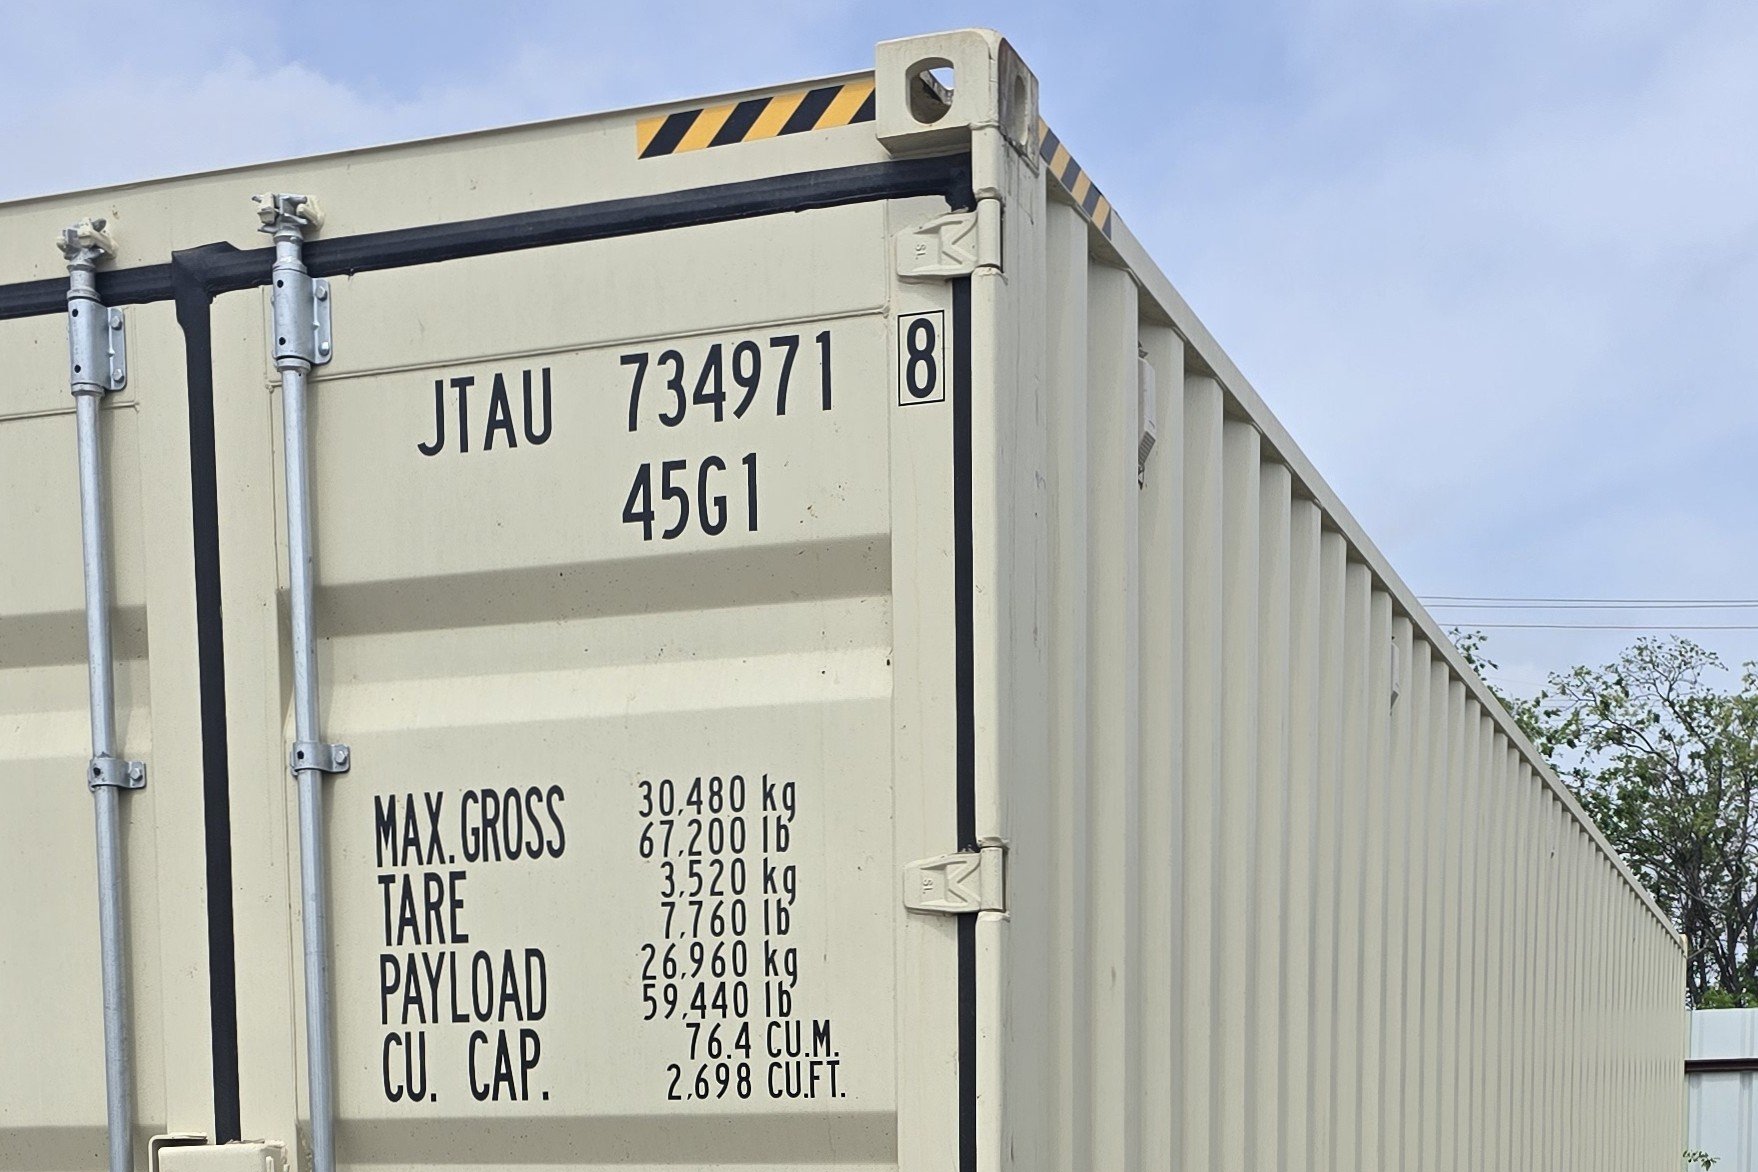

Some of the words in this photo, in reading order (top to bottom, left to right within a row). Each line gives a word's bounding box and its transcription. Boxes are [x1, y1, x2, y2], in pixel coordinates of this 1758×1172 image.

[417, 367, 552, 457] JTAU
[619, 330, 832, 433] 734971
[906, 317, 937, 399] 8
[622, 452, 758, 542] 45G1
[638, 774, 746, 818] 30,480
[762, 773, 796, 824] kg
[639, 816, 746, 859] 67,200
[762, 814, 790, 854] lb
[660, 857, 746, 899] 3,520
[762, 856, 796, 907] kg
[377, 870, 469, 947] TARE
[660, 898, 747, 940] 7,760
[763, 897, 790, 936] lb
[379, 948, 547, 1025] PAYLOAD
[640, 939, 747, 982] 26,960
[764, 939, 798, 989] kg
[643, 980, 749, 1021] 59,440
[764, 979, 792, 1018] lb
[382, 1030, 437, 1103] CU.
[468, 1028, 550, 1102] CAP.
[685, 1021, 752, 1061] 76.4
[766, 1019, 840, 1059] CU.M.
[666, 1062, 752, 1101] 2,698
[767, 1059, 846, 1099] CU.FT.
